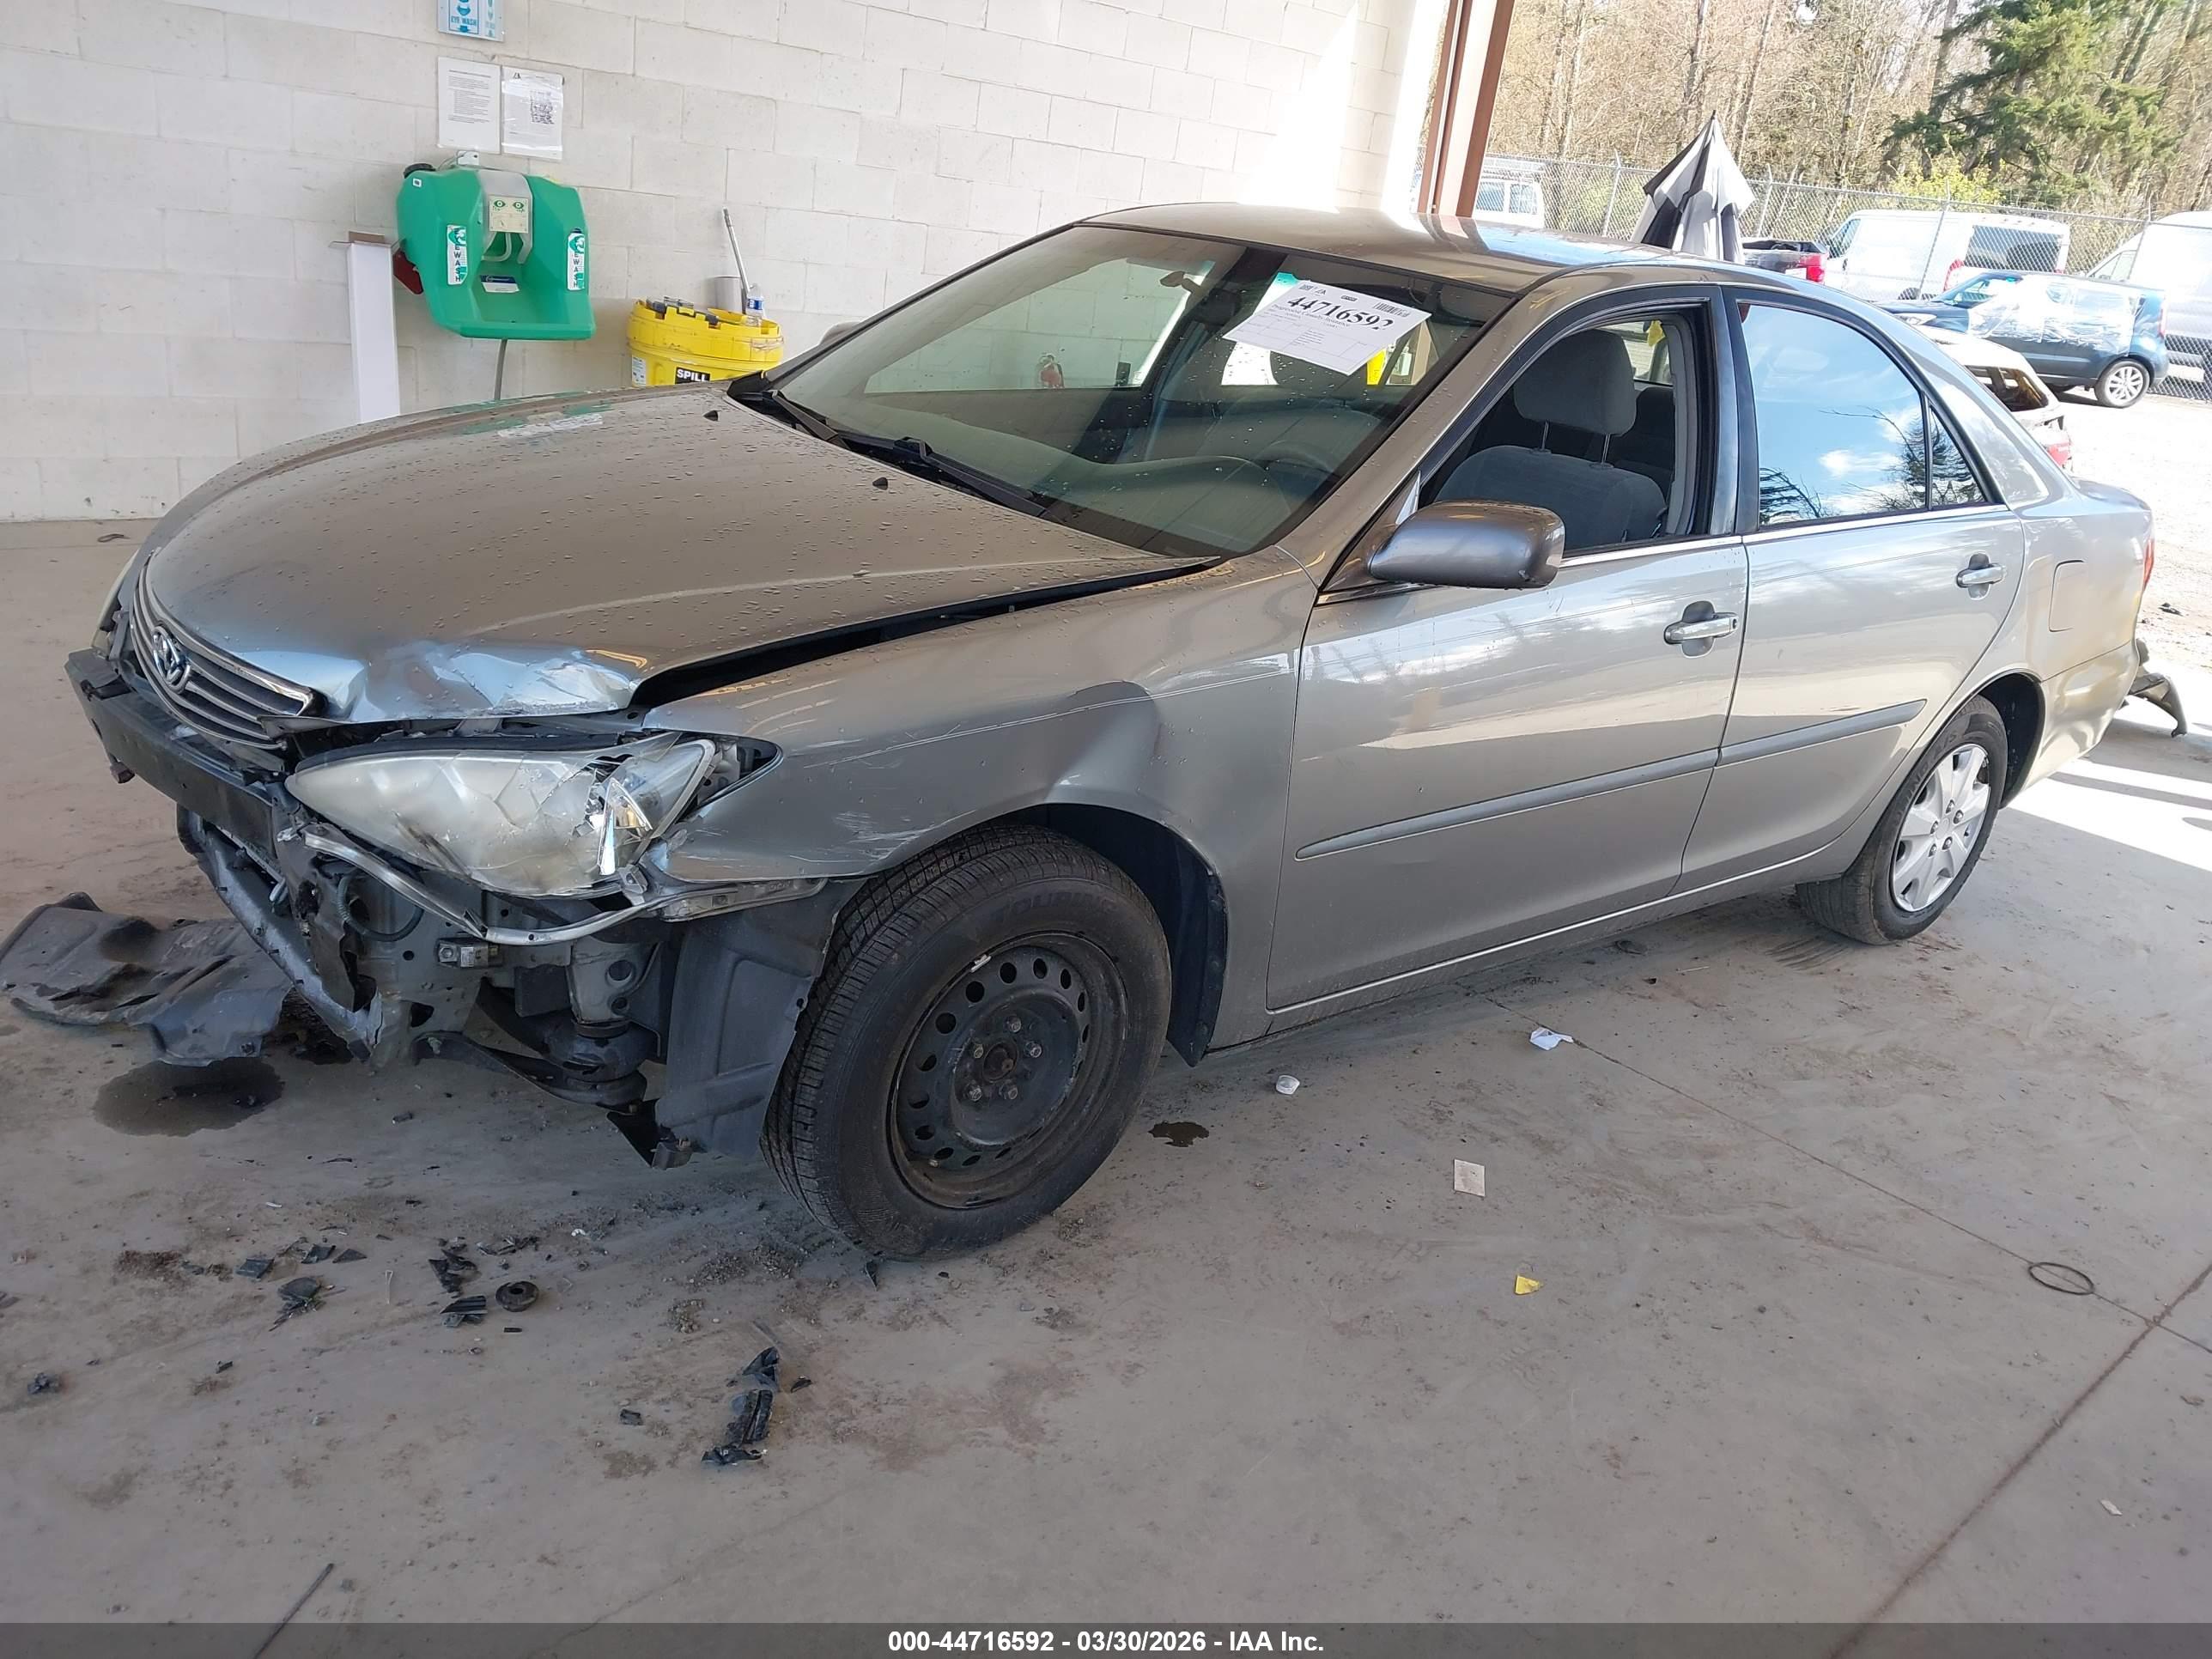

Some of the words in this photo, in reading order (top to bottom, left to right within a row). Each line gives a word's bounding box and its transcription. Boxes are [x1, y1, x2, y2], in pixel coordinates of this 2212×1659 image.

[461, 17, 477, 26] WASH
[1287, 296, 1395, 331] 44716592
[677, 368, 707, 383] SPILL
